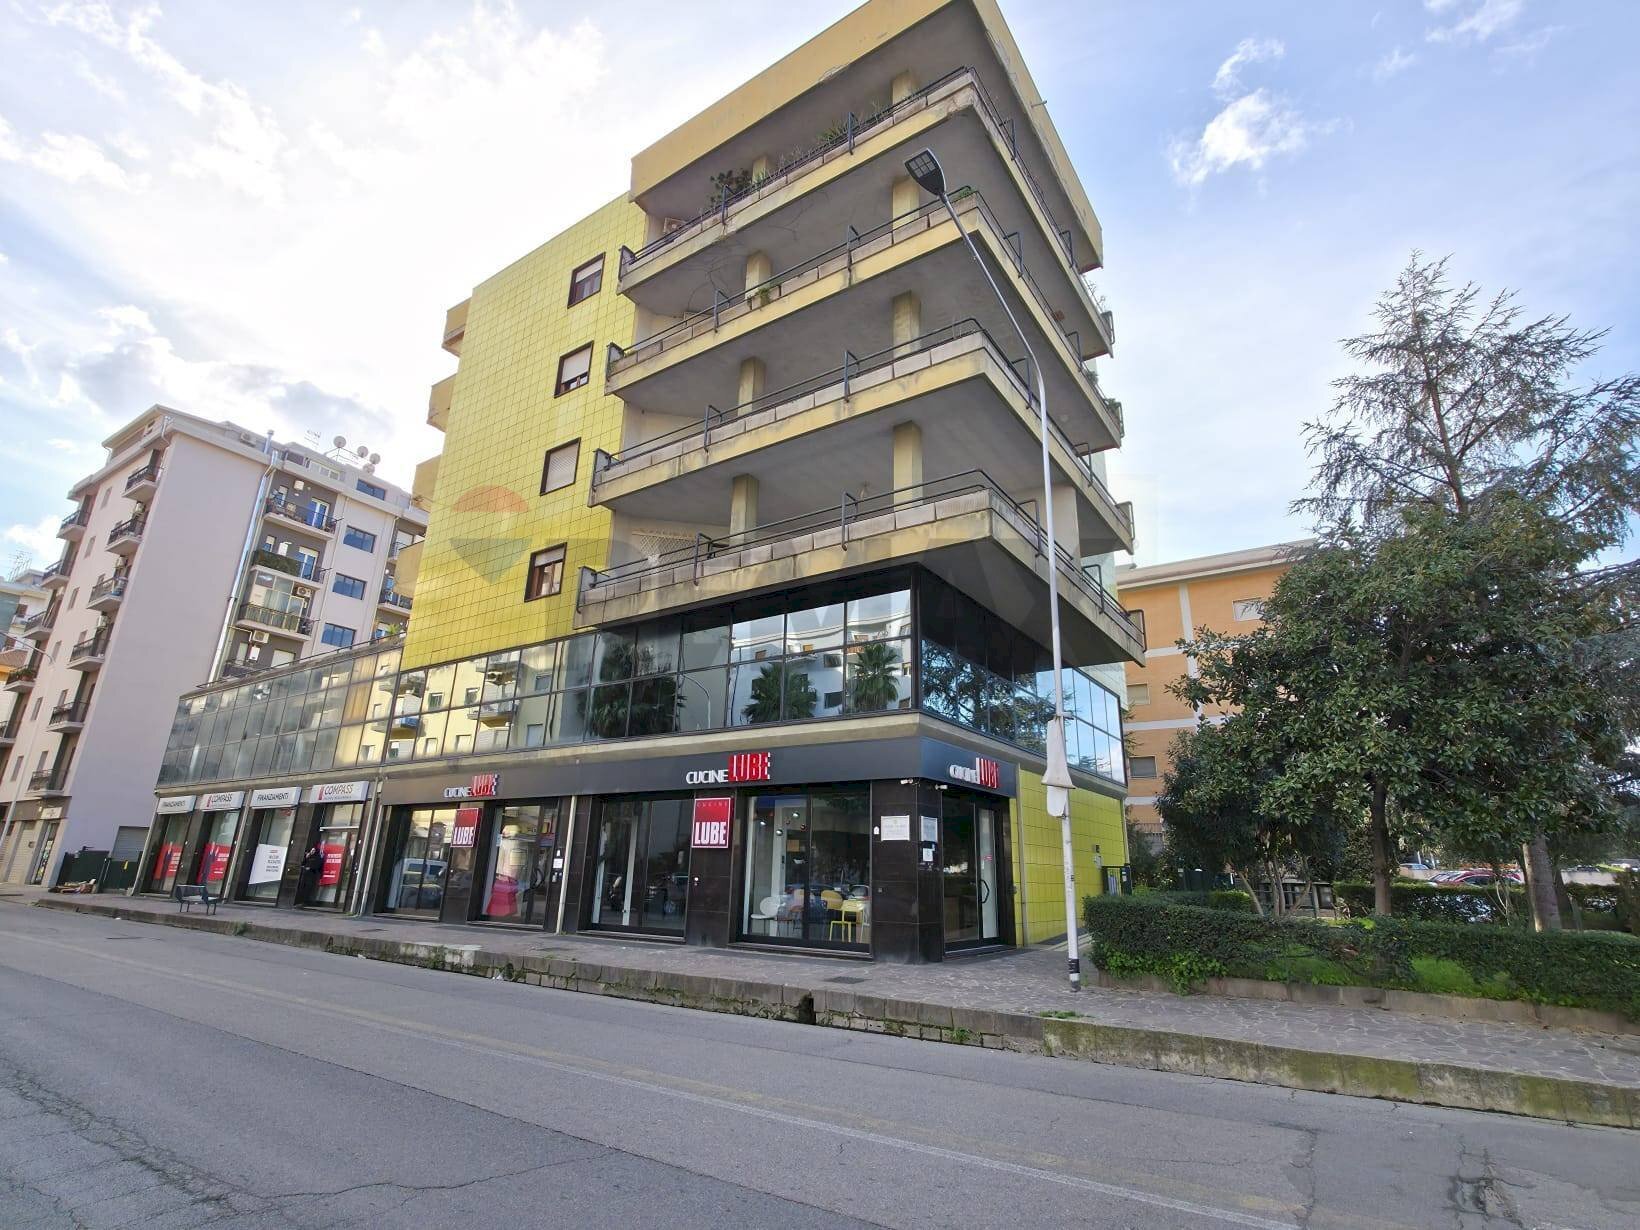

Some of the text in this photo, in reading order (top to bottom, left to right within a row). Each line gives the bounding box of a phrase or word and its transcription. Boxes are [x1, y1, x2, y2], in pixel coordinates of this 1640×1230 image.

[686, 752, 770, 784] CUCINE LUBE
[324, 784, 354, 796] COMPASS
[453, 826, 475, 845] LUBE
[694, 821, 727, 845] LUBE
